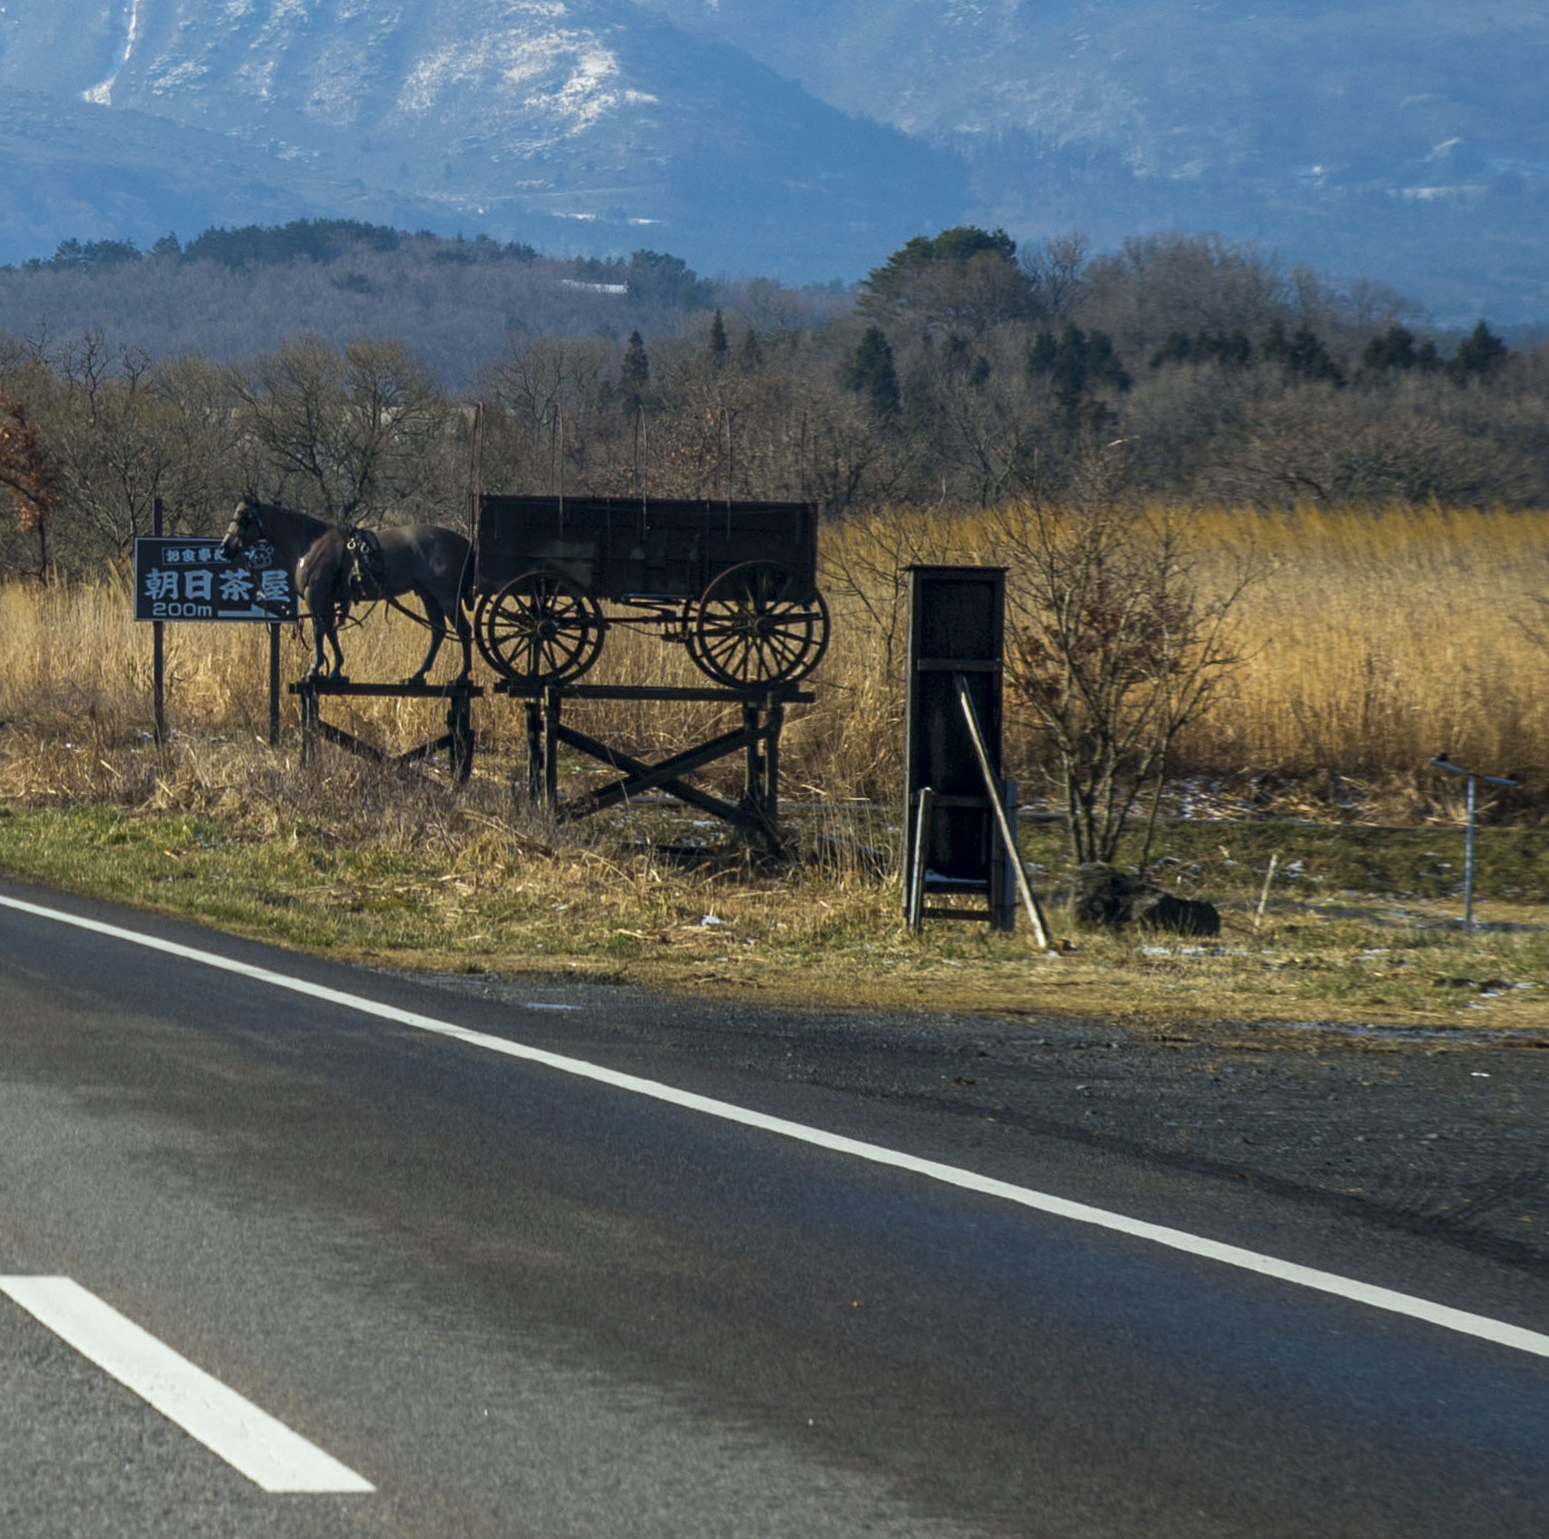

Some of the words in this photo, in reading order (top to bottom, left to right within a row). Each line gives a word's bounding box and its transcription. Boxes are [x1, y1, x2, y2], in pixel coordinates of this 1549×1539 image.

[144, 567, 291, 603] 朝日茶屋
[153, 602, 212, 617] 200m
